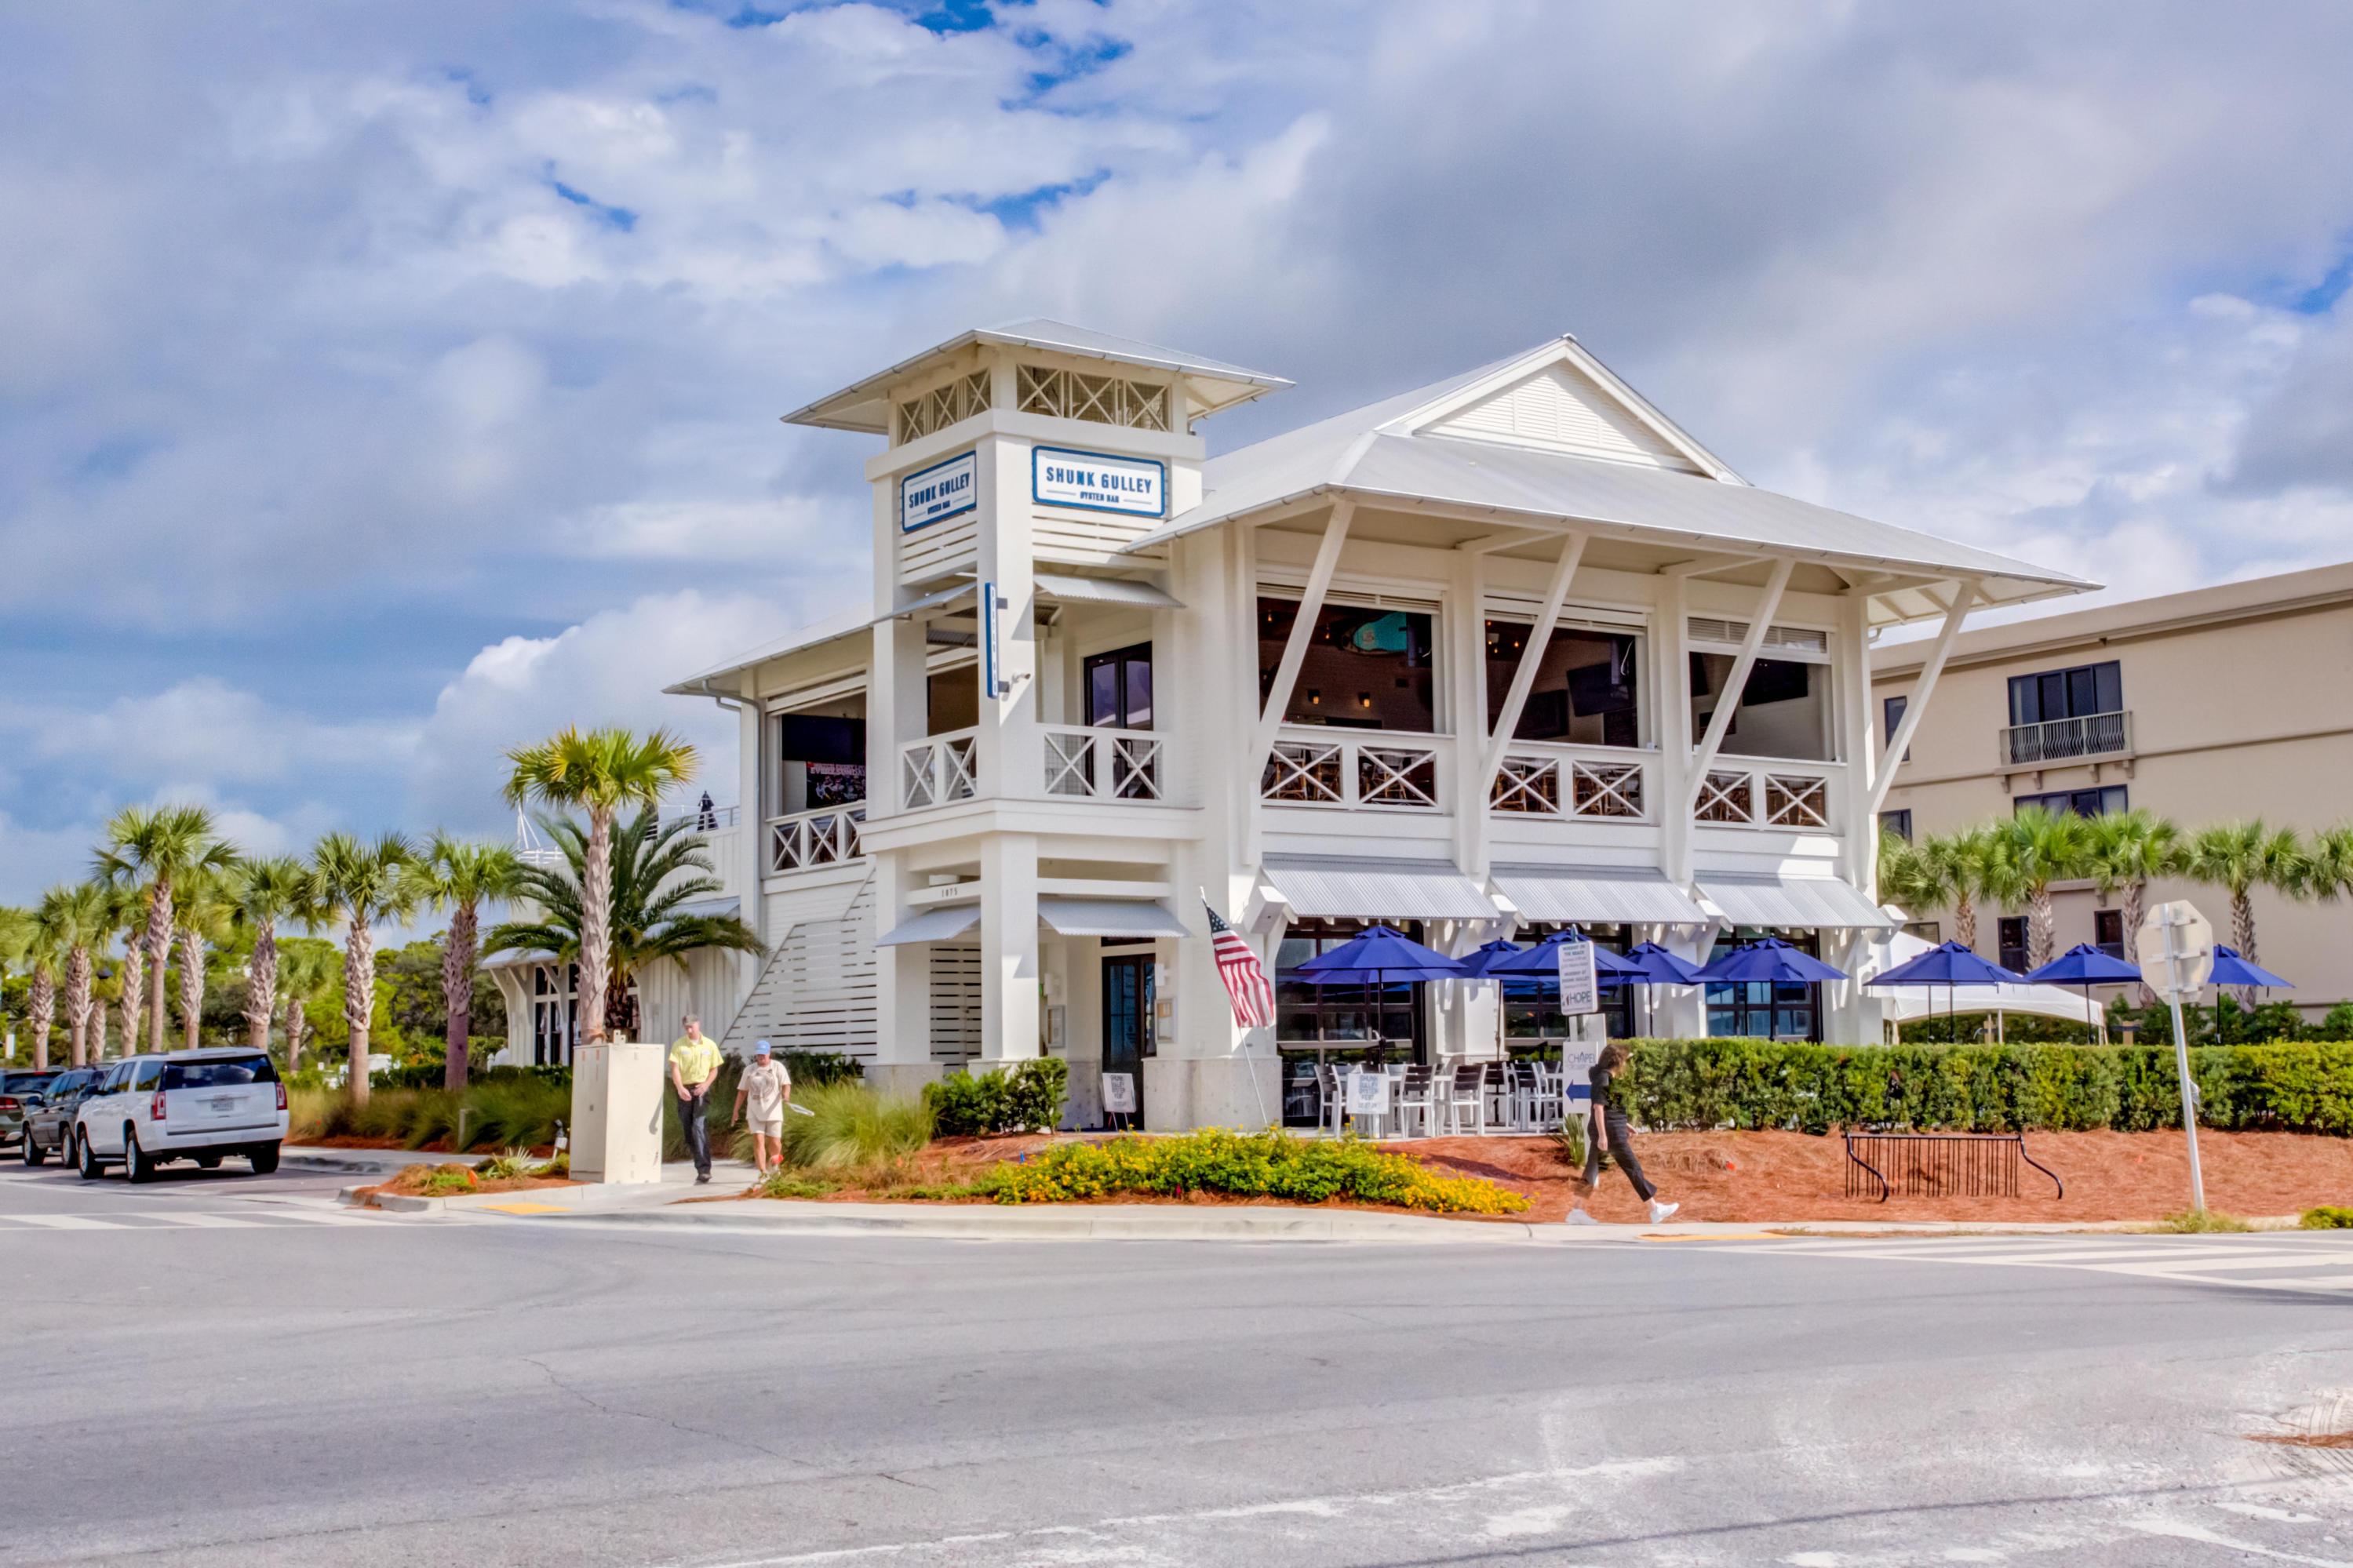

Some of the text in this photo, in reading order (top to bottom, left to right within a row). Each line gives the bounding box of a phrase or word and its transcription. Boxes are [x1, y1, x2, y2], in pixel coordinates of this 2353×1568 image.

[1046, 466, 1152, 494] SHUNK GULLEY
[909, 485, 937, 508] SHUNK
[939, 472, 970, 497] GULLEY
[1080, 491, 1120, 503] OYSTER BAR
[1569, 991, 1592, 1004] HOPE
[1568, 1051, 1596, 1064] CHAPEL
